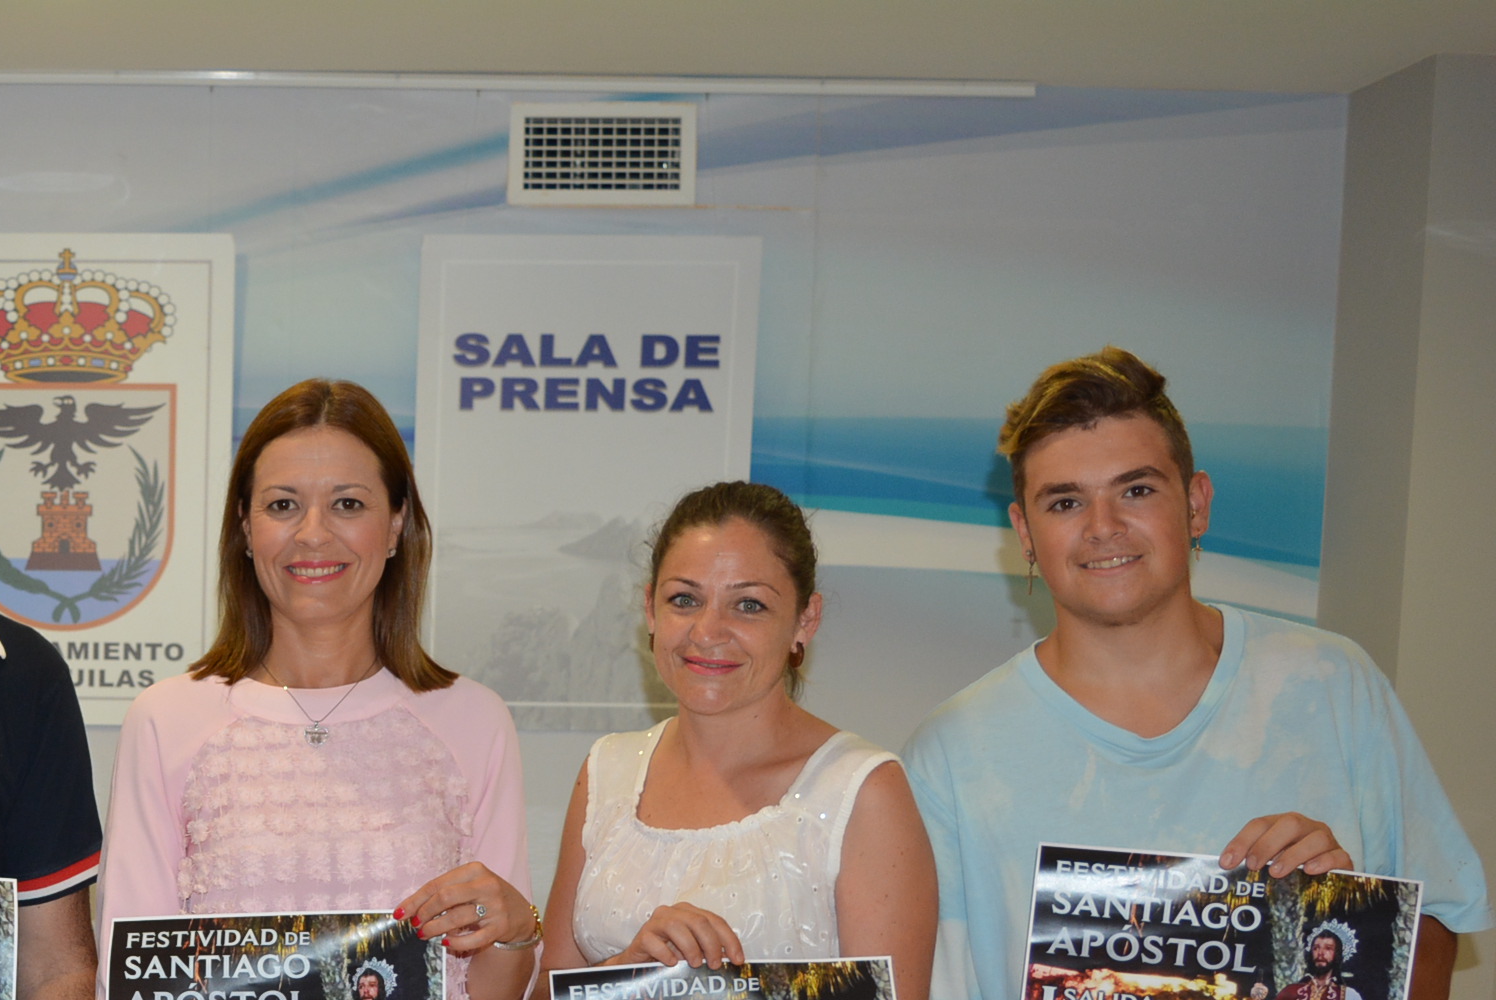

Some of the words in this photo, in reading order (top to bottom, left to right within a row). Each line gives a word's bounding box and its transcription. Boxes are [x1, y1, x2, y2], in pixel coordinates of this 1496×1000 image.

[453, 332, 617, 369] SALA
[640, 334, 721, 369] DE
[459, 376, 714, 413] PRENSA
[1235, 881, 1265, 897] DE
[1052, 890, 1261, 931] SANTIAGO
[126, 929, 277, 948] FESTIVIDAD
[285, 932, 310, 946] DE
[1046, 924, 1256, 973] APÓSTOL
[124, 954, 310, 979] SANTIAGO
[733, 978, 760, 993] DE
